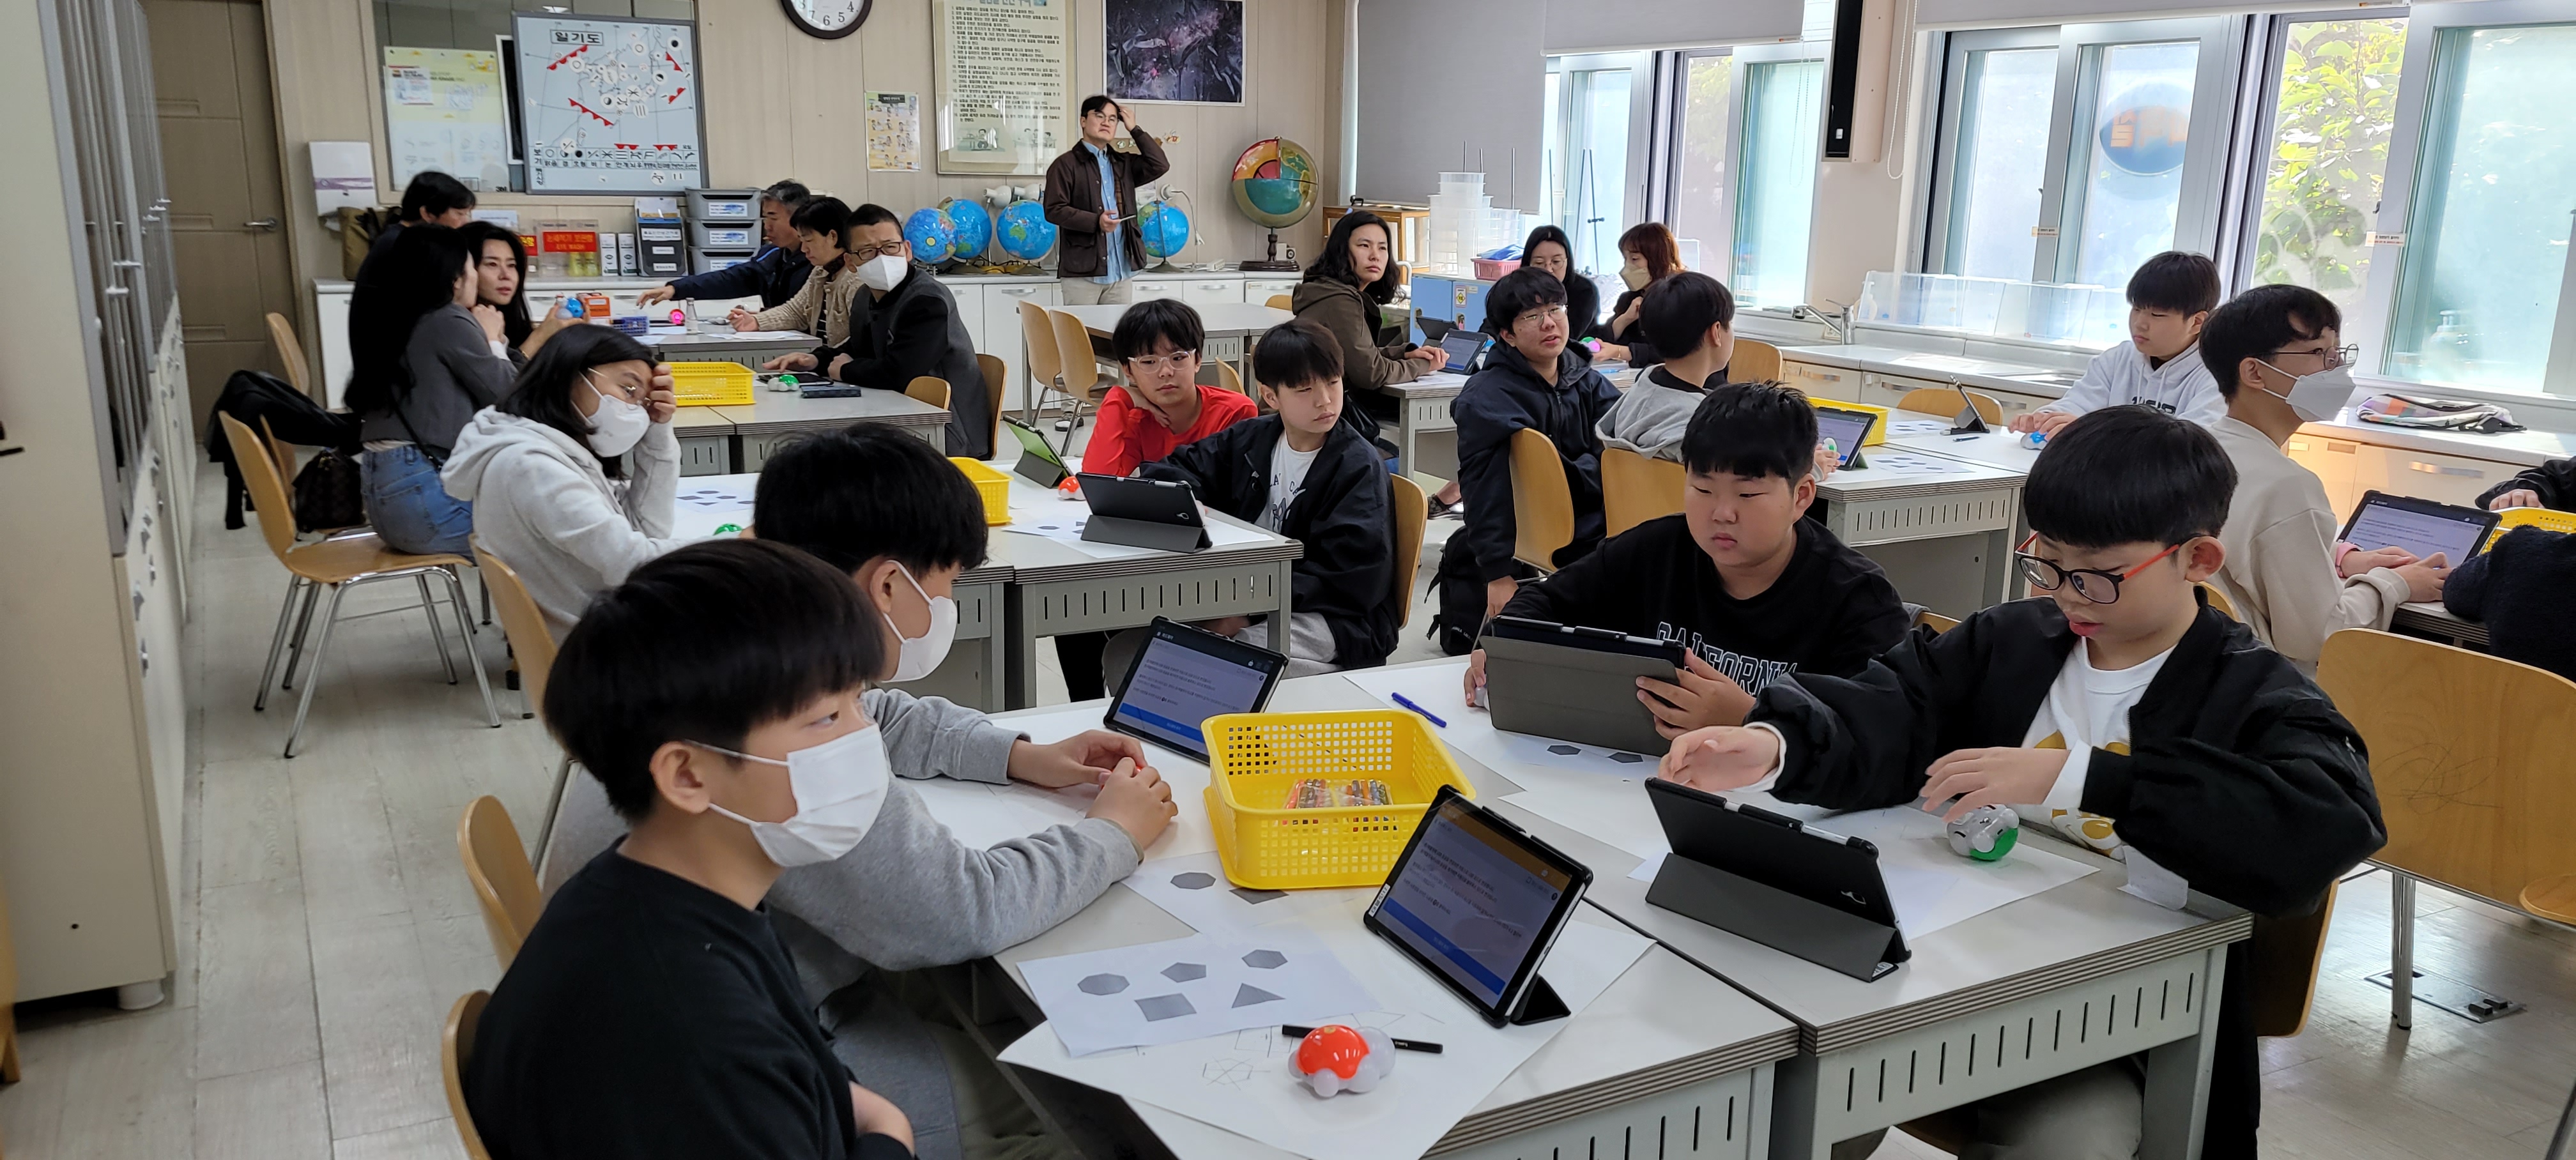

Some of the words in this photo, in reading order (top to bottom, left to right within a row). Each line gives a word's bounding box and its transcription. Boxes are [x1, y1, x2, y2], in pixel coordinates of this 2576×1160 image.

[847, 1, 855, 12] 4
[809, 10, 815, 19] 7
[838, 12, 845, 22] 5
[823, 15, 831, 26] 6
[555, 32, 601, 43] 일기도
